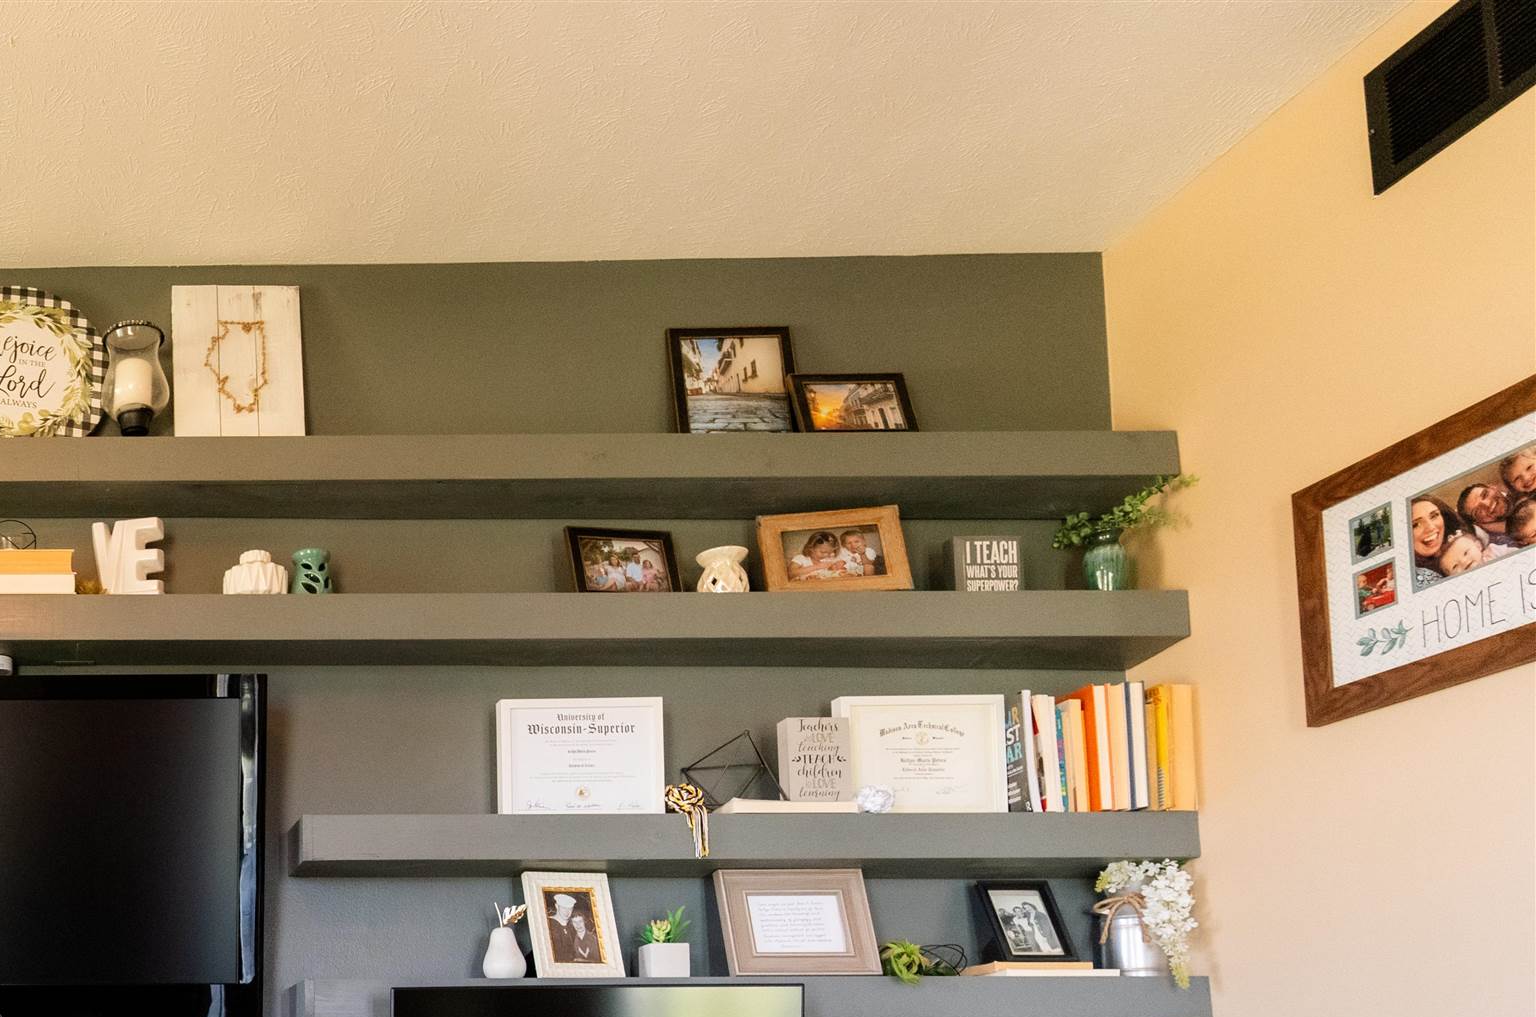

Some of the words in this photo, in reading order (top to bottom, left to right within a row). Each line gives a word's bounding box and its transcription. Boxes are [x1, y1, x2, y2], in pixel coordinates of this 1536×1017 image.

[30, 360, 47, 368] THE
[0, 398, 38, 409] ALWAYS
[965, 541, 971, 564] I
[974, 540, 1018, 564] TEACH
[966, 565, 996, 579] WHAT'S
[998, 565, 1018, 578] YOUR
[966, 579, 1019, 592] SUPERPOWER?
[1422, 581, 1506, 648] HOME
[557, 712, 596, 722] University
[527, 722, 636, 736] Wisconsin-Superior
